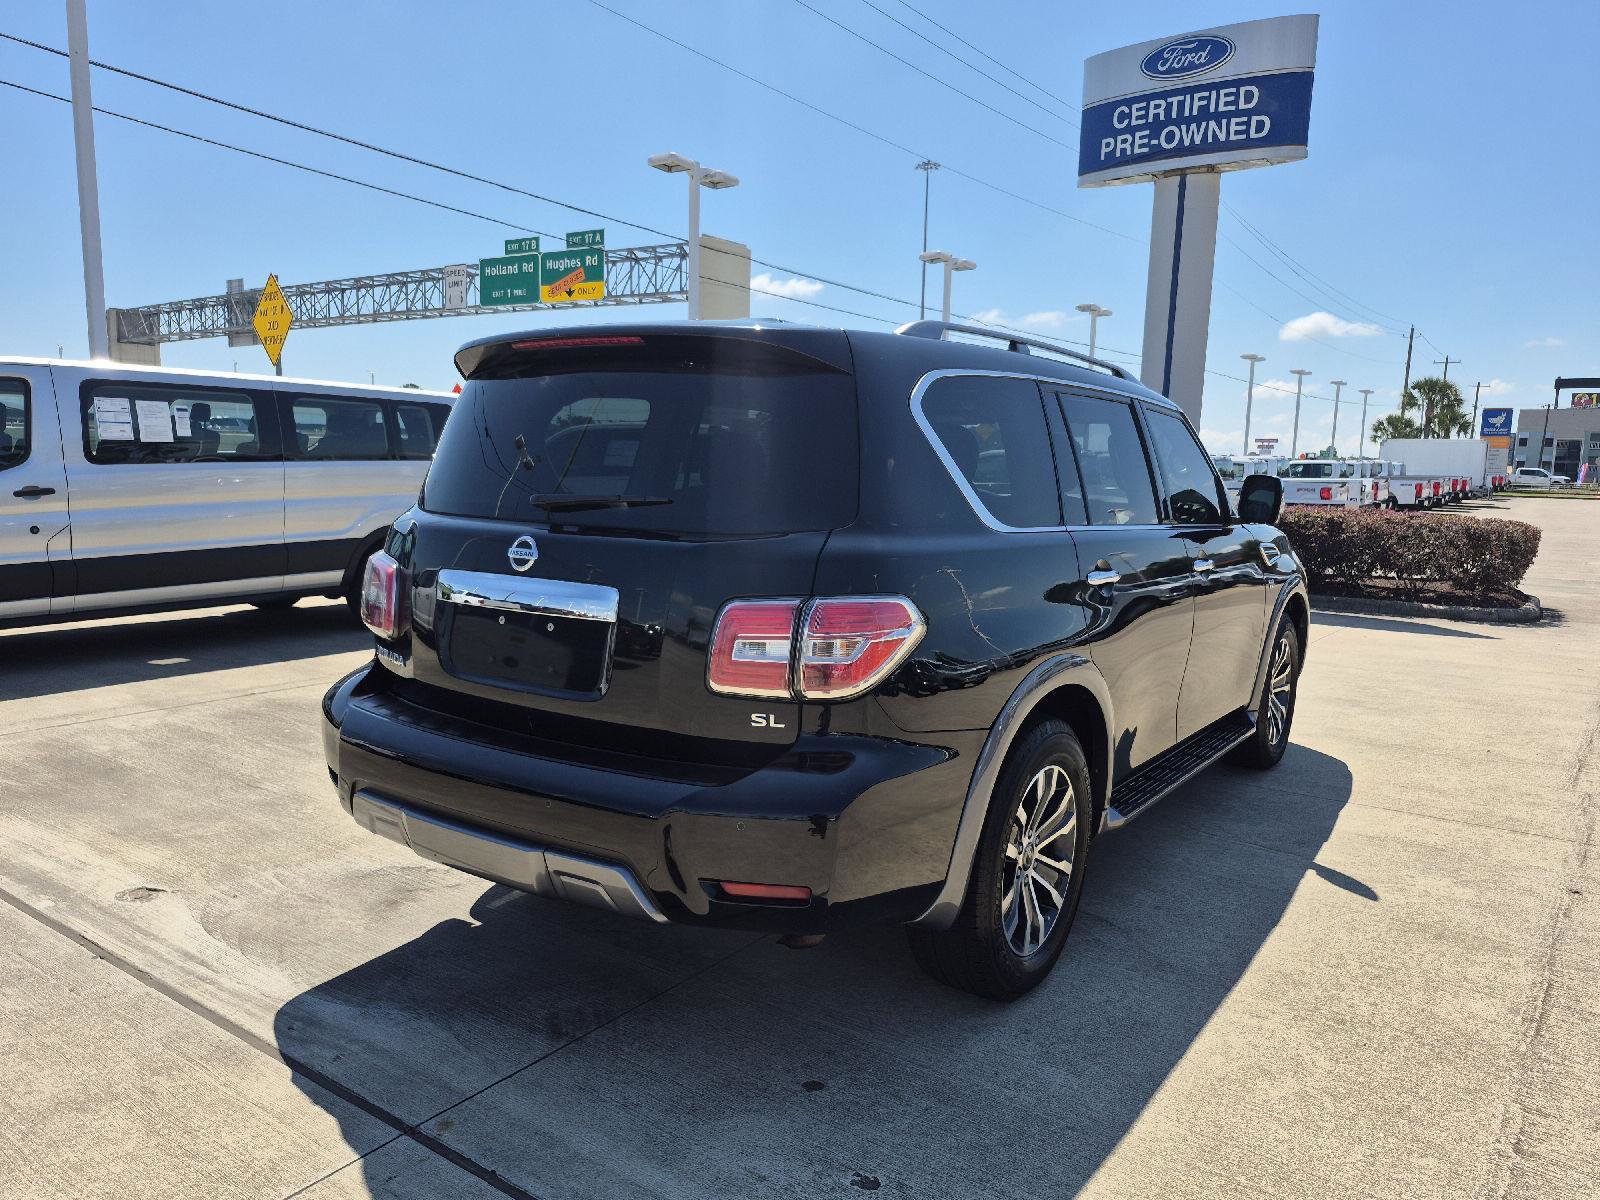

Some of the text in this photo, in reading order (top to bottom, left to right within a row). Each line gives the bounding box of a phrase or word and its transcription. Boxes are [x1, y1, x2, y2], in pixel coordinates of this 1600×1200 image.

[1157, 41, 1211, 71] Ford
[1112, 85, 1260, 129] CERTIFIED
[1100, 115, 1271, 161] PRE-OWNED
[569, 233, 601, 244] EXIT 17 A
[507, 240, 537, 251] EXIT 17 B
[546, 254, 598, 271] Hughes Rd
[446, 269, 466, 277] SPEED
[485, 261, 534, 276] Holland Rd
[448, 280, 463, 288] LIMIT
[492, 290, 504, 298] EXIT
[507, 288, 511, 298] 1
[577, 286, 597, 295] ONLY
[510, 549, 534, 557] NISSAN
[750, 713, 786, 728] SL
